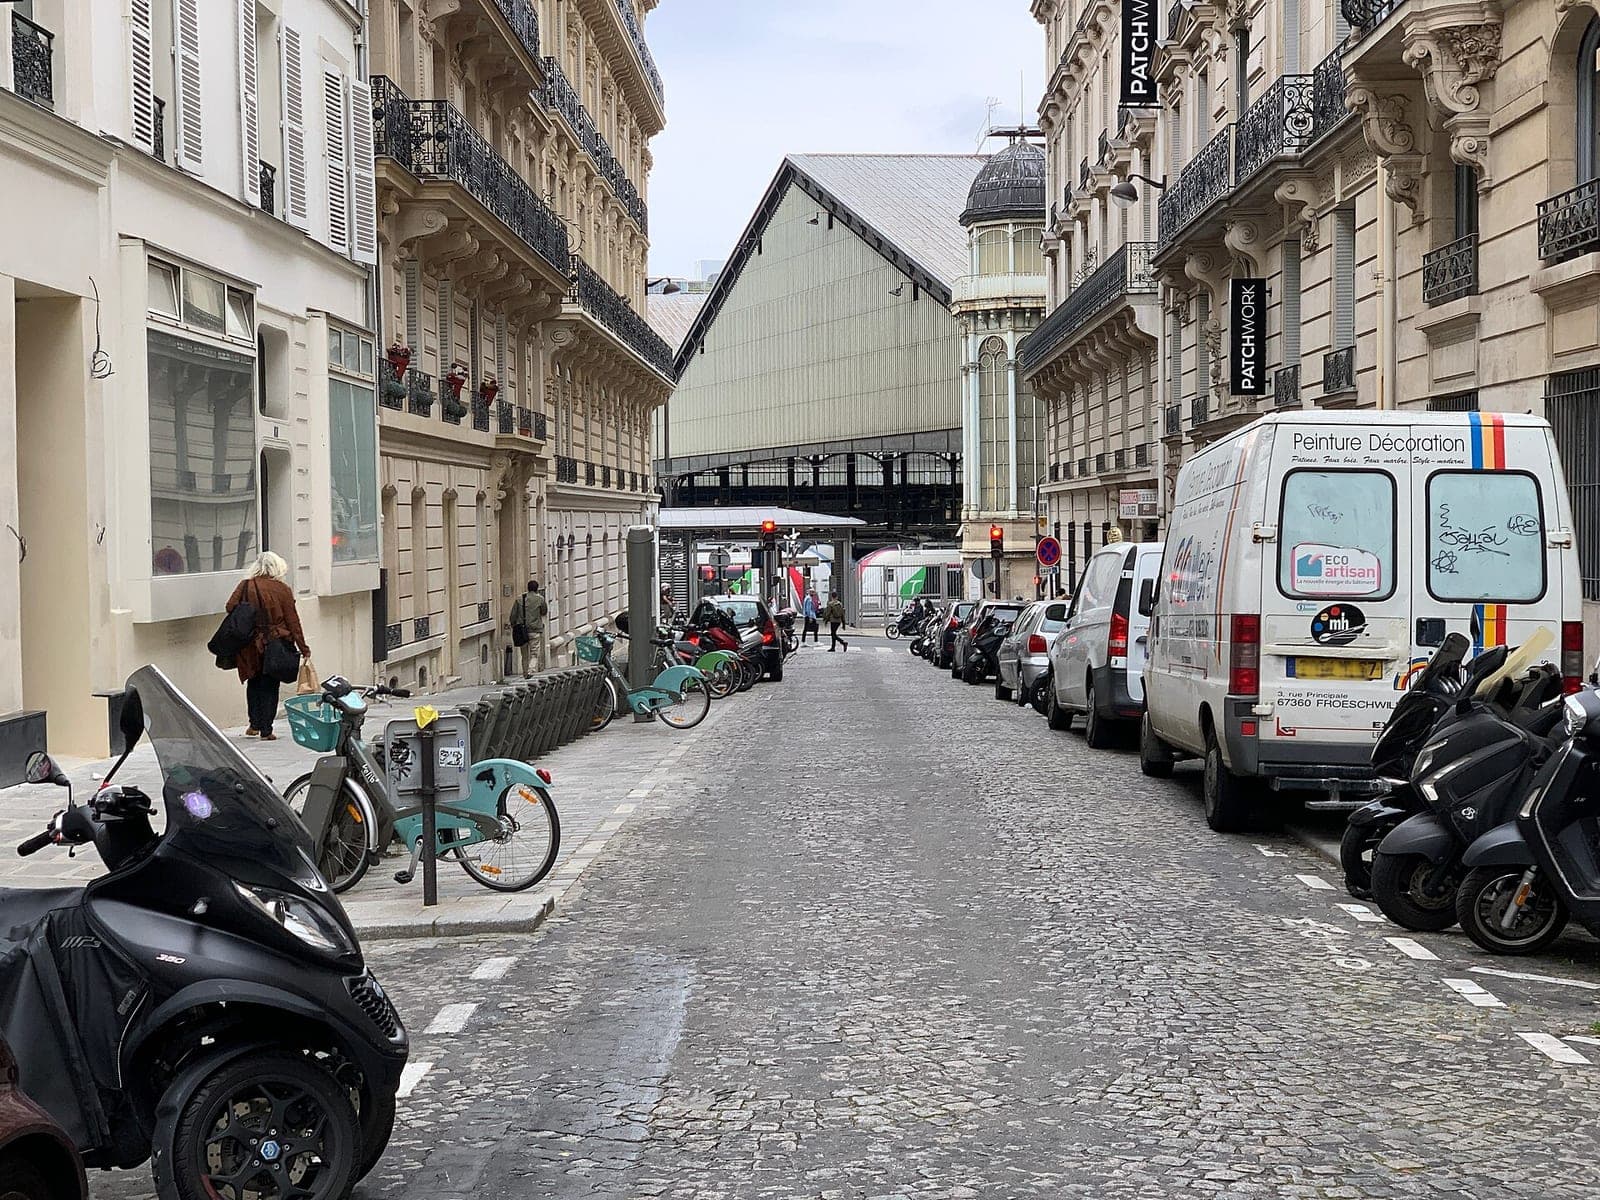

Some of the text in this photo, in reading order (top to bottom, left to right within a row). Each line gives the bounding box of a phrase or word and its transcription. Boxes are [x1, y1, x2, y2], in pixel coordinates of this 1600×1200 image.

[1241, 284, 1256, 390] PATCHWORK
[1293, 432, 1465, 452] Peinture Décoration
[1323, 455, 1340, 464] Faux
[1363, 455, 1380, 464] Faux
[1325, 555, 1349, 565] ECO
[1325, 566, 1376, 578] artisan
[1329, 612, 1349, 631] mh
[1306, 691, 1348, 699] Principale
[1277, 699, 1399, 710] 67360 FROESCHWIL
[155, 953, 186, 964] 350
